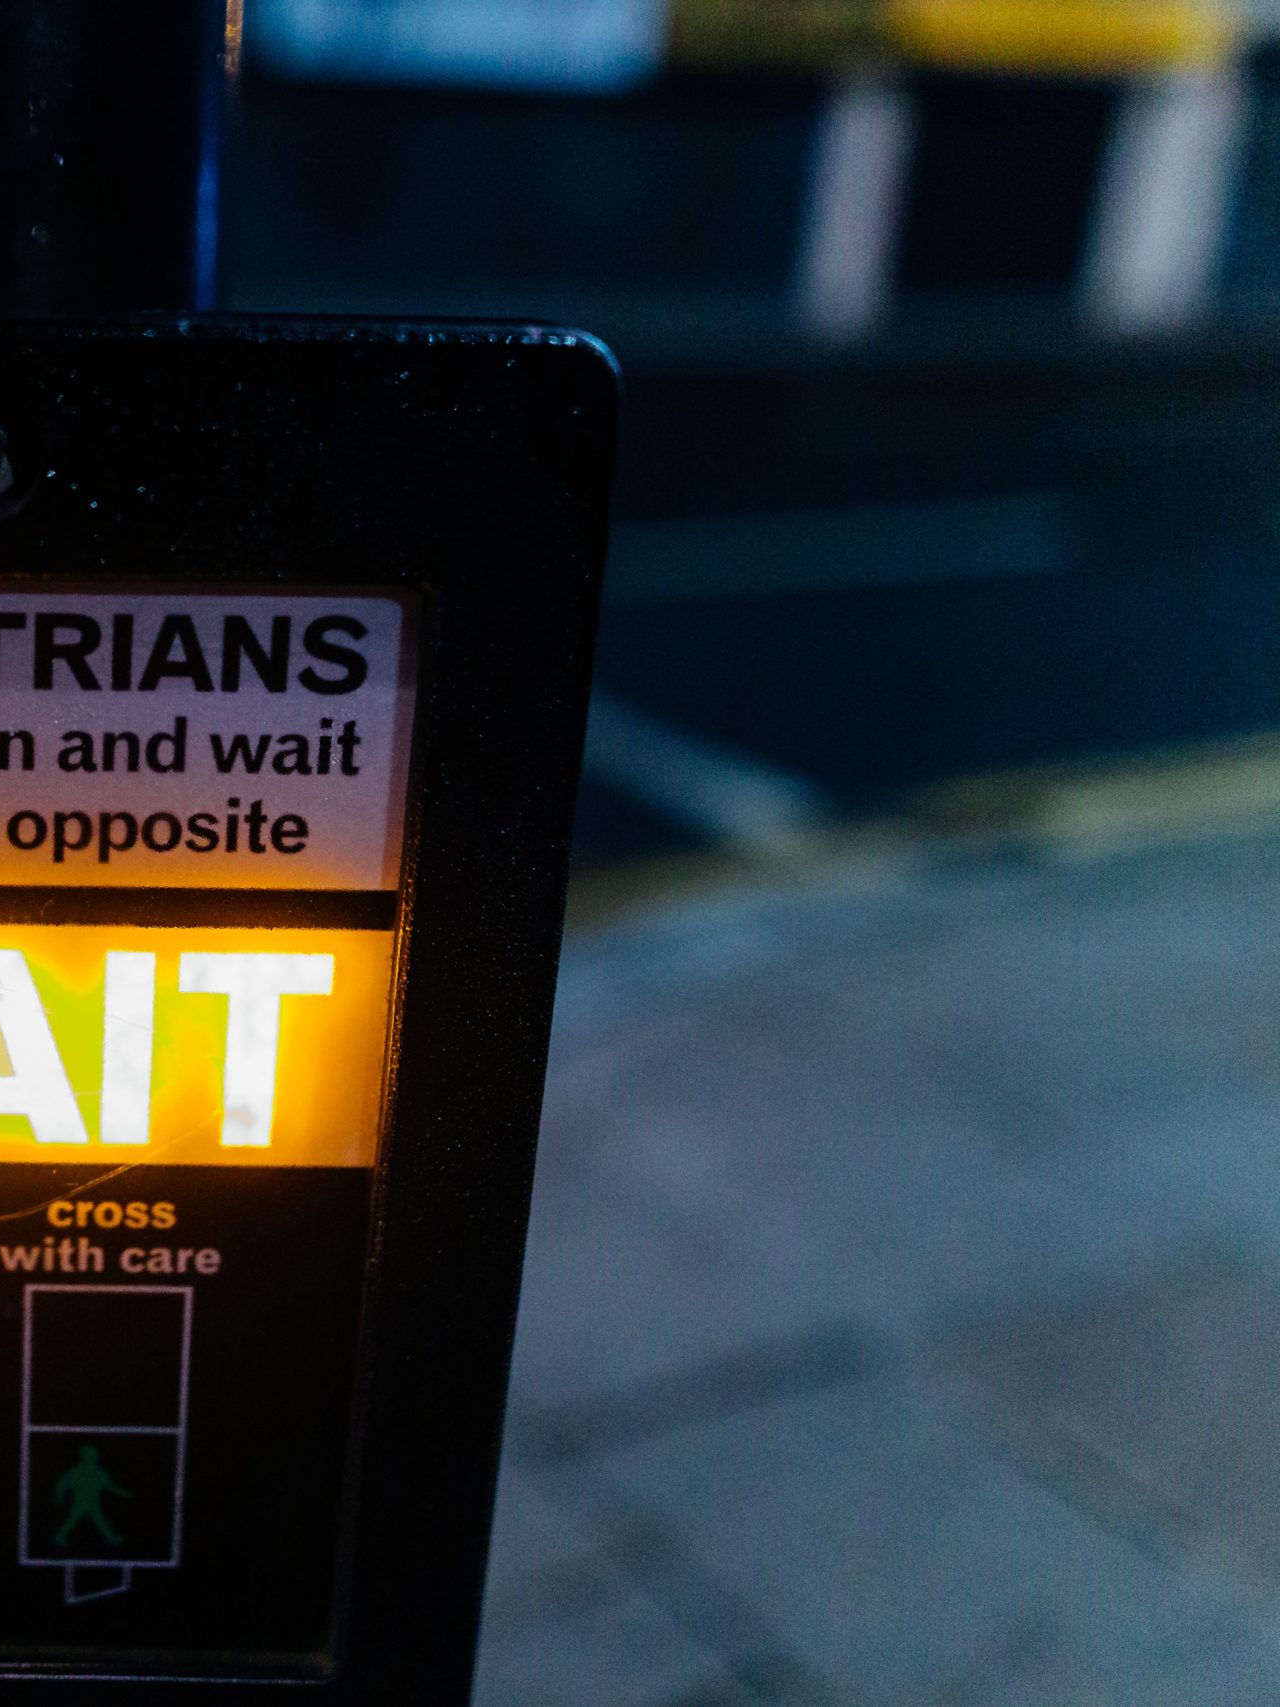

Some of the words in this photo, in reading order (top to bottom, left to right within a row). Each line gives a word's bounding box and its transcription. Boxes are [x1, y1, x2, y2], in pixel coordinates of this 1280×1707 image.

[57, 717, 188, 775] and
[210, 717, 361, 777] wait
[6, 798, 310, 864] opposite
[46, 1200, 177, 1229] cross
[0, 1237, 105, 1273] with
[119, 1244, 222, 1275] care
